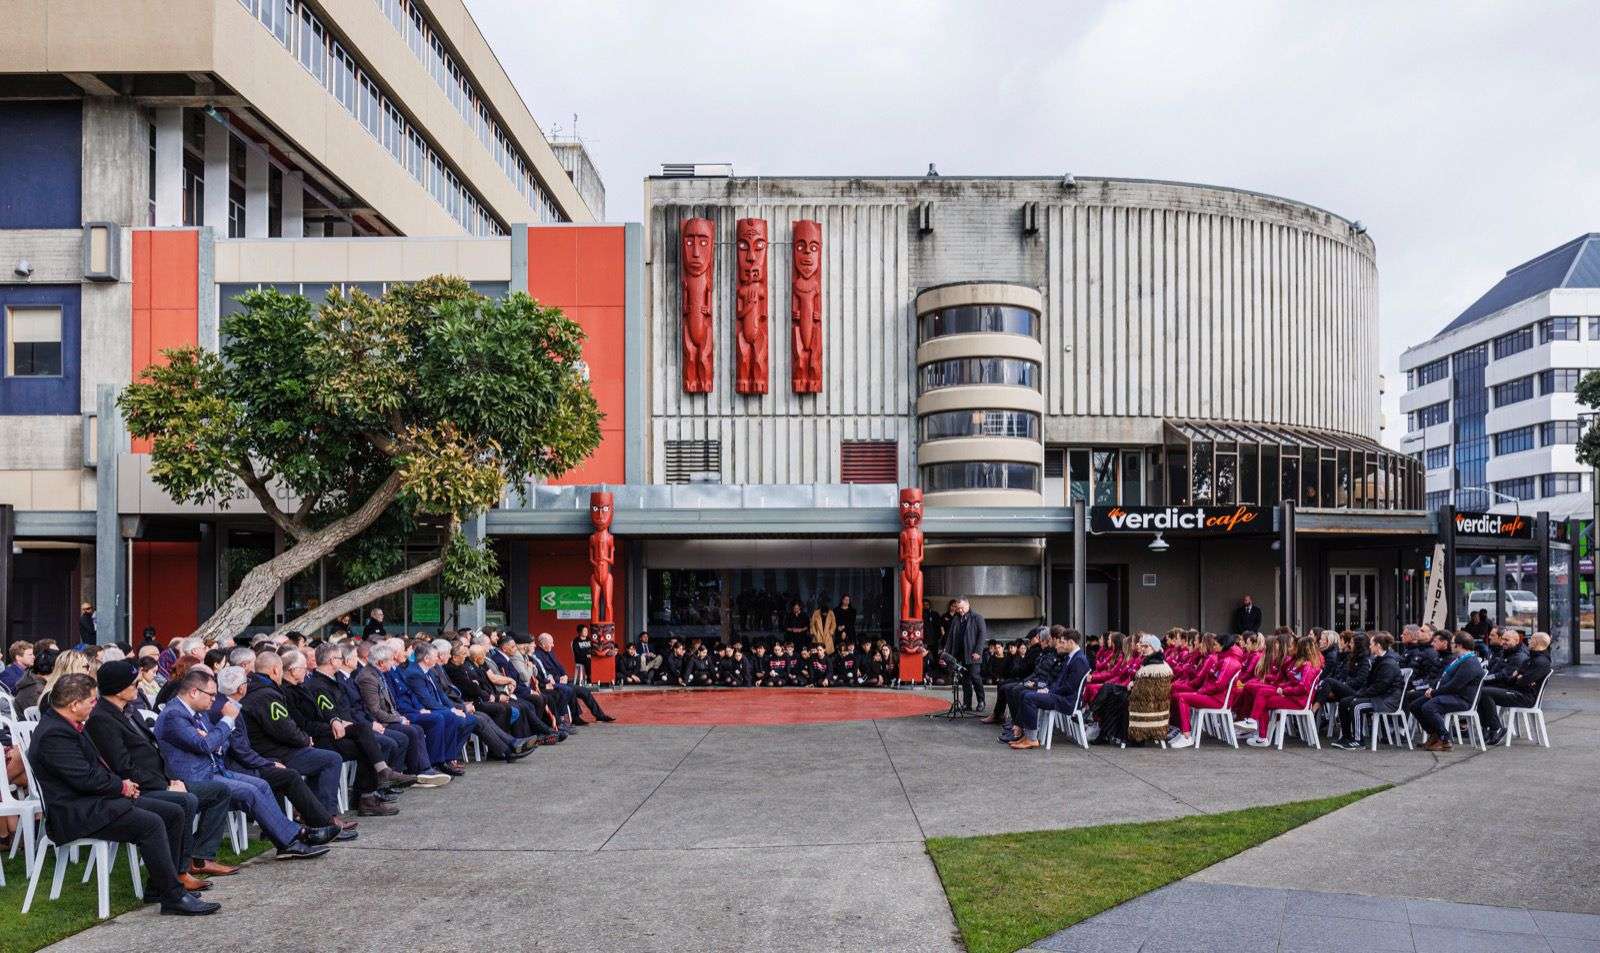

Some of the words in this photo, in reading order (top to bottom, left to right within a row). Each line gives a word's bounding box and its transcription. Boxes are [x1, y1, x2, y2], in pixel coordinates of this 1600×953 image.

[1111, 508, 1205, 529] verdict
[1206, 506, 1258, 532] cafe
[1456, 514, 1502, 534] verdict
[1501, 515, 1524, 537] cafe
[1430, 578, 1443, 626] COFF
